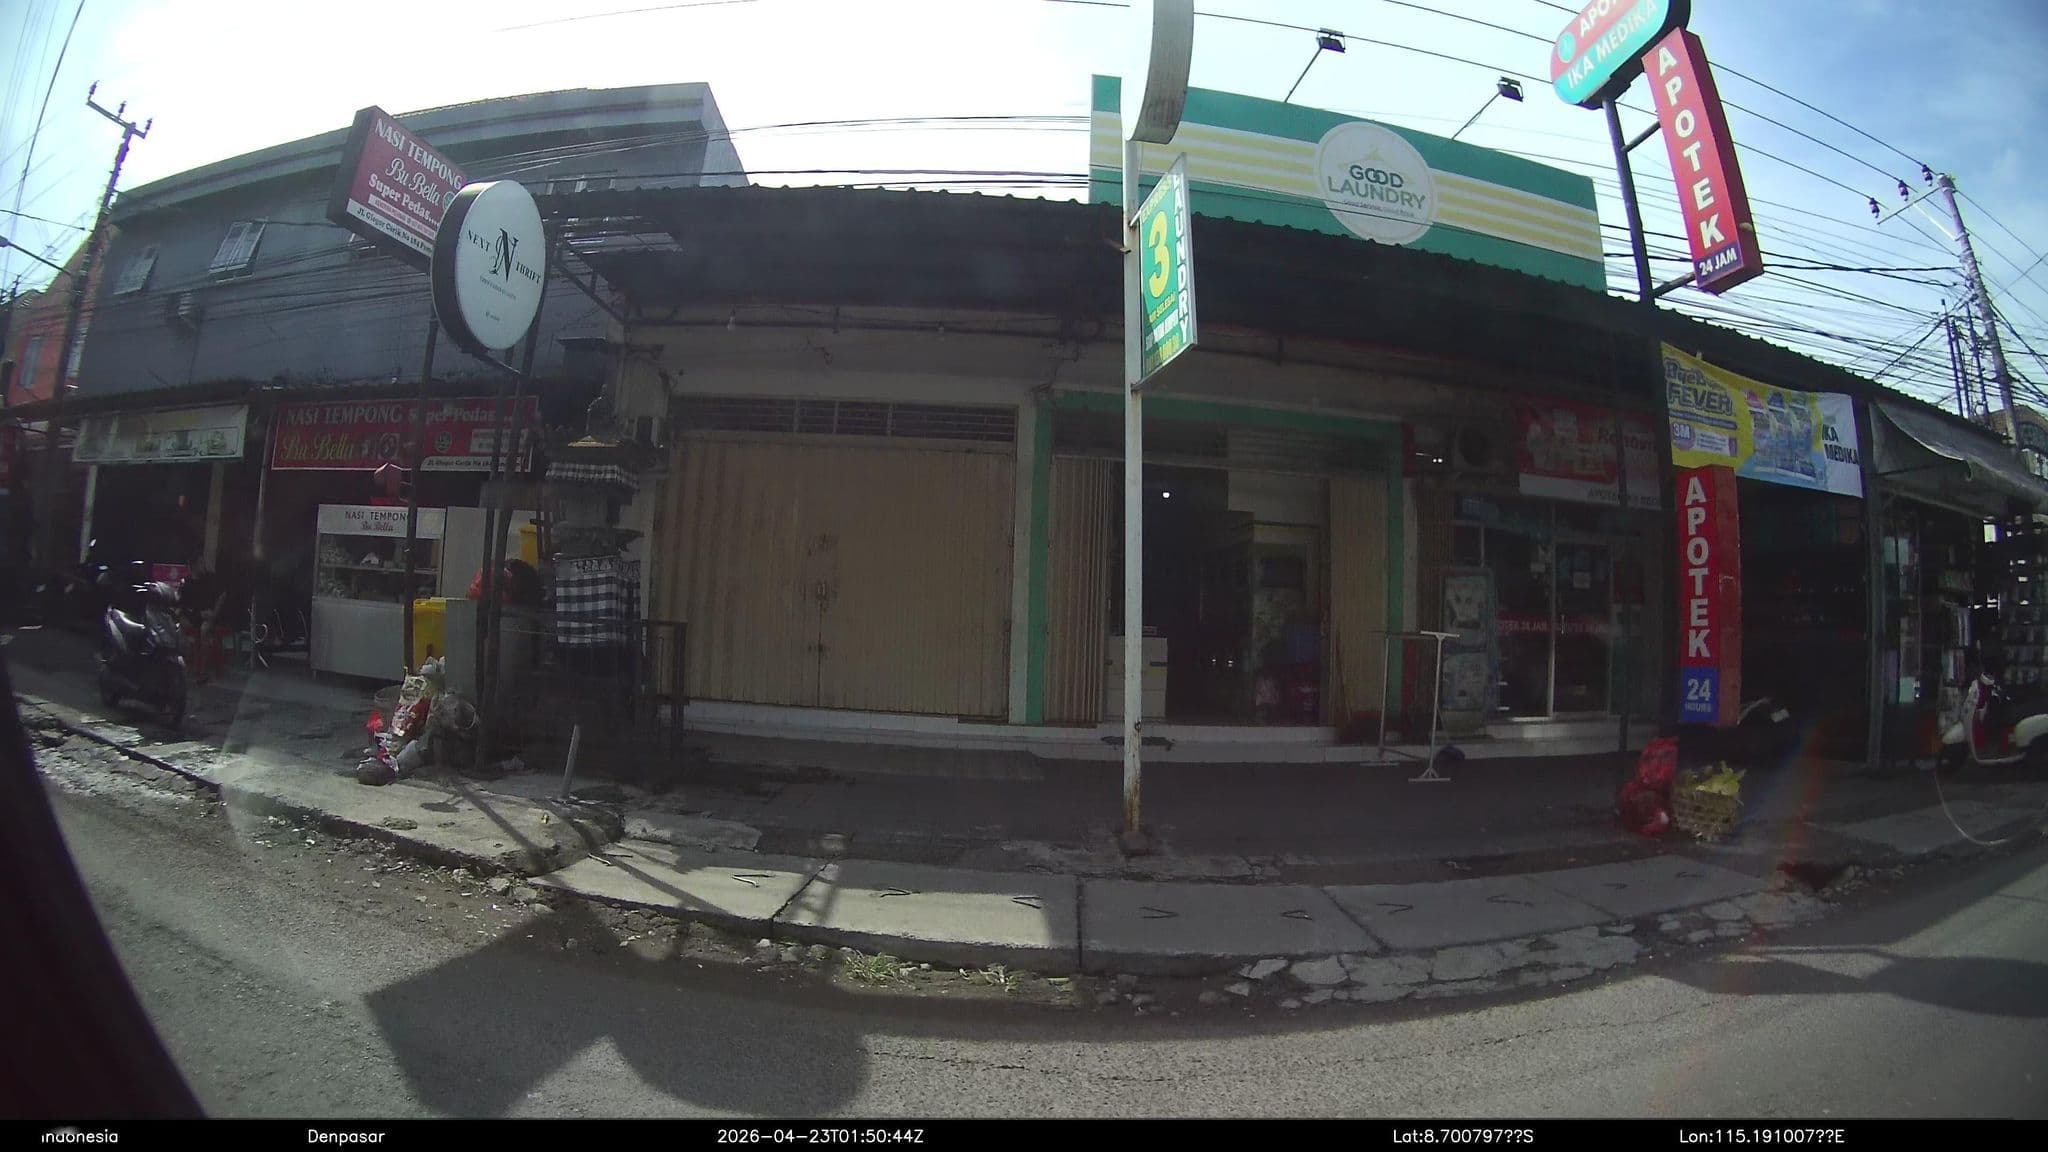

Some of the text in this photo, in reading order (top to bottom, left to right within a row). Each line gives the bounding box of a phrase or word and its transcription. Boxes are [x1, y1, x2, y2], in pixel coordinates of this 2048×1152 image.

[1567, 0, 1658, 89] IKA MEDIKA
[374, 118, 463, 190] NASI TEMPONG
[1657, 46, 1726, 250] APOTEK
[368, 173, 401, 203] Super
[385, 158, 441, 206] Bu Bella
[1350, 164, 1404, 188] GOOD
[1327, 175, 1425, 209] LAUNDRY
[467, 229, 490, 252] NEXT
[1148, 210, 1170, 298] 3
[516, 261, 541, 284] THRIFT
[1173, 172, 1189, 344] LAUNDRY
[1697, 250, 1739, 277] 24 JAM
[1666, 381, 1733, 416] FEVER
[286, 408, 320, 426] NASI
[323, 405, 403, 424] TEMPONG
[279, 430, 354, 461] Bu Bella
[1822, 424, 1839, 442] IKA
[1824, 444, 1860, 465] MEDIKA
[345, 511, 365, 520] NASI
[1684, 476, 1712, 658] APOTEK
[1686, 678, 1711, 702] 24
